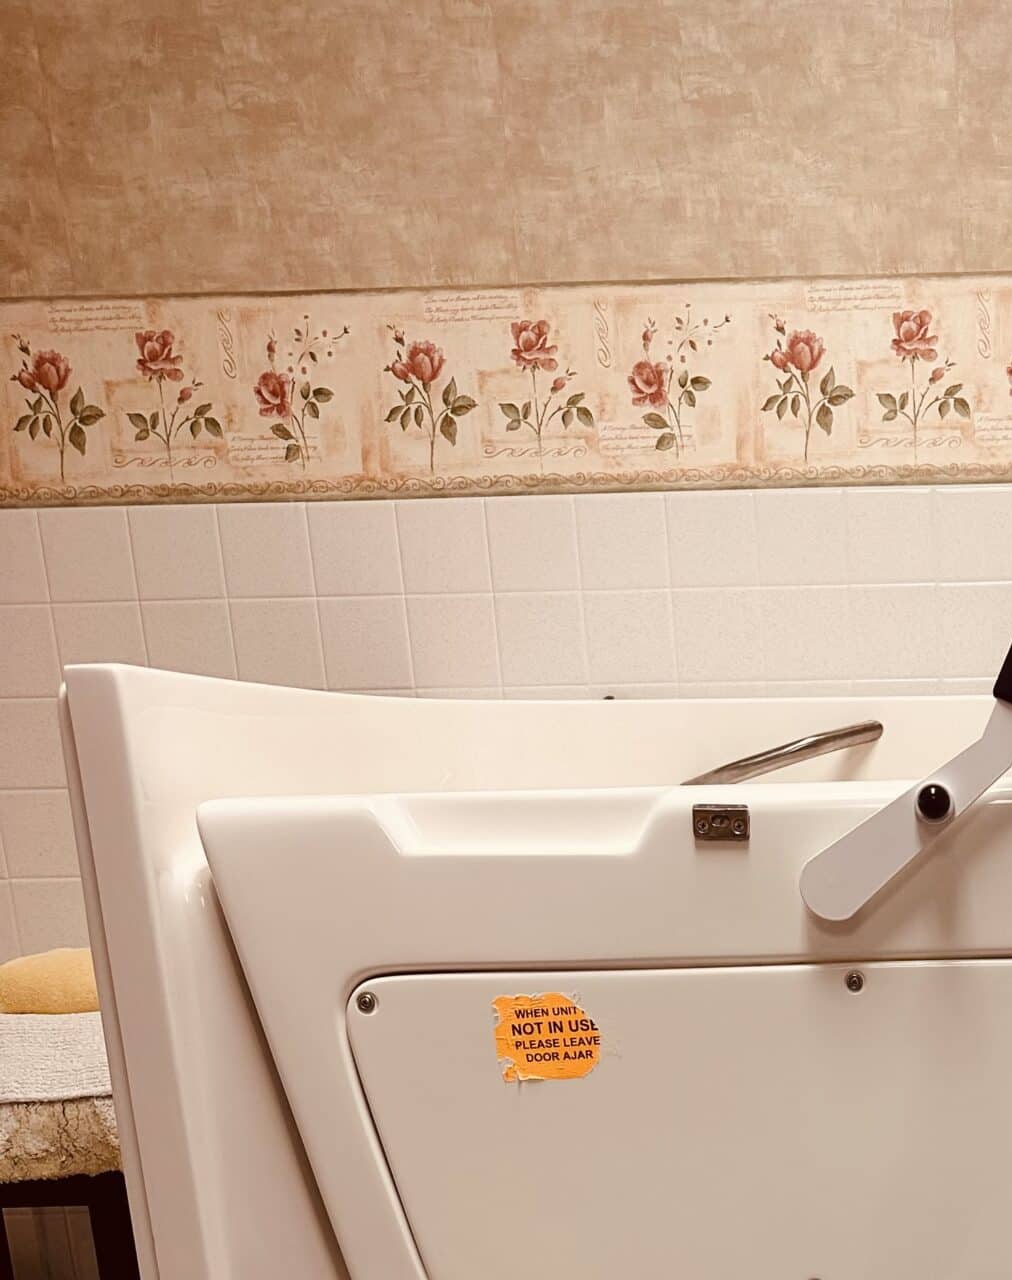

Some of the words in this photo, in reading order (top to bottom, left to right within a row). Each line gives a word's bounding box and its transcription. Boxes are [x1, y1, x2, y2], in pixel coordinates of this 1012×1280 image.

[514, 1008, 549, 1019] WHEN
[552, 1006, 577, 1016] UNIT
[511, 1022, 543, 1036] NOT
[548, 1020, 563, 1034] IN
[515, 1039, 560, 1050] PLEASE
[563, 1036, 600, 1047] LEAVE
[526, 1052, 560, 1062] DOOR
[563, 1050, 593, 1060] AJAR
